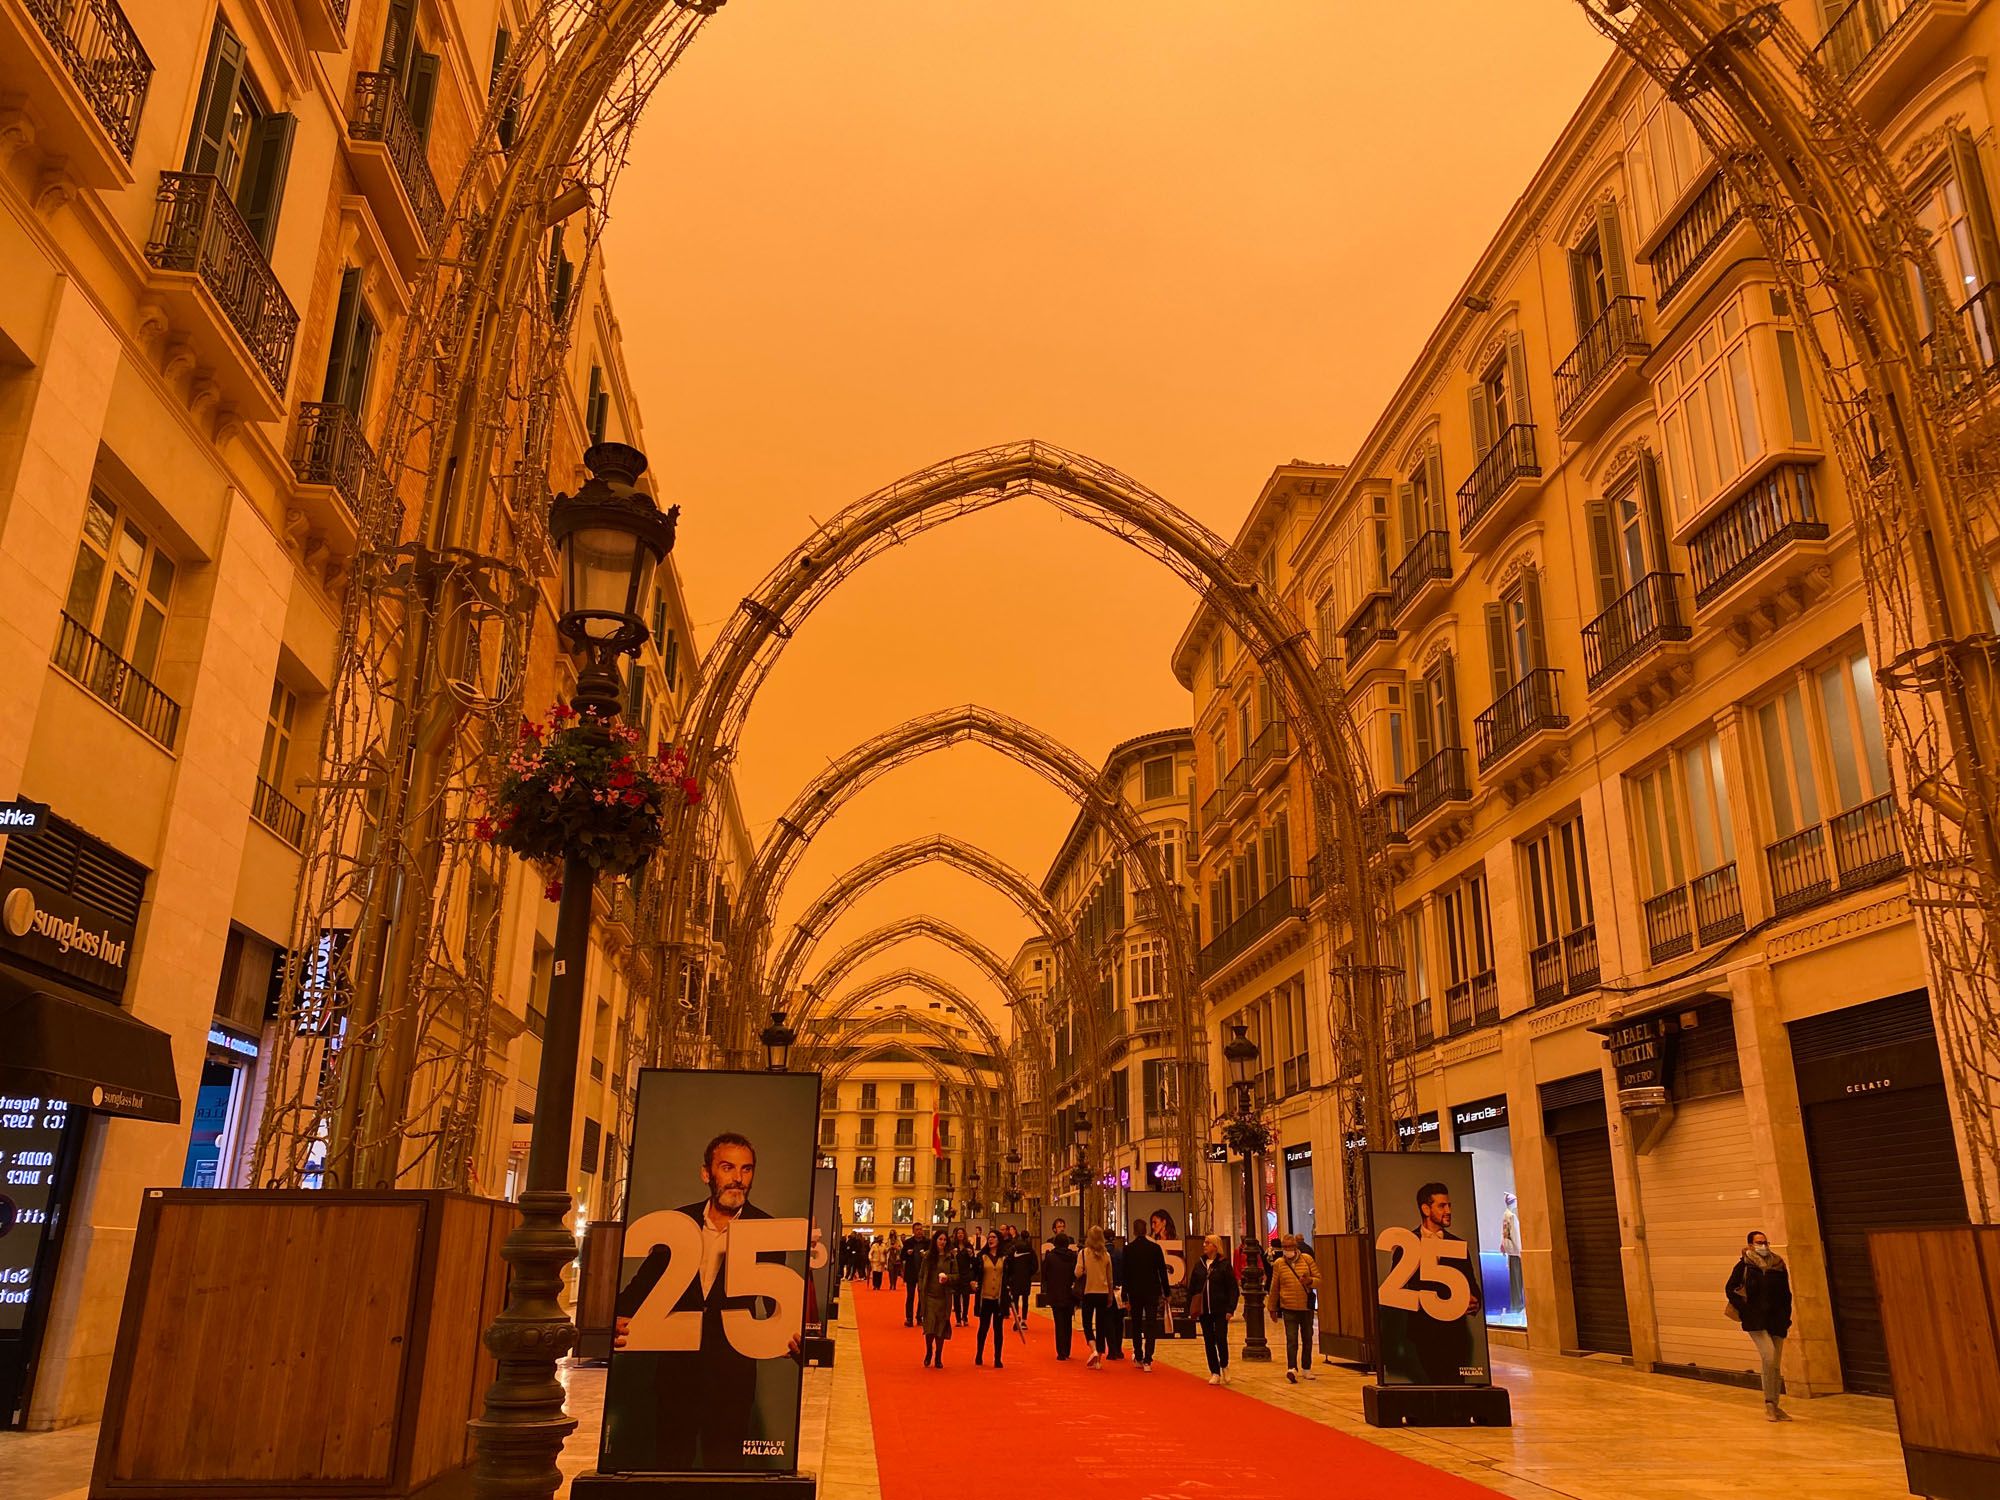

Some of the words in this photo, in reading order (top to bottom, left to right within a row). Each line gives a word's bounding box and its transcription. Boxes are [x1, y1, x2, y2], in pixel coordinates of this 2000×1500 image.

[32, 909, 100, 956] sunglass
[99, 930, 126, 968] hut
[1609, 1023, 1652, 1049] RAFAEL
[104, 1091, 132, 1108] sunglass
[132, 1093, 144, 1108] hut
[1846, 1079, 1891, 1093] GELATO
[614, 1210, 808, 1360] 25
[1376, 1226, 1471, 1321] 25
